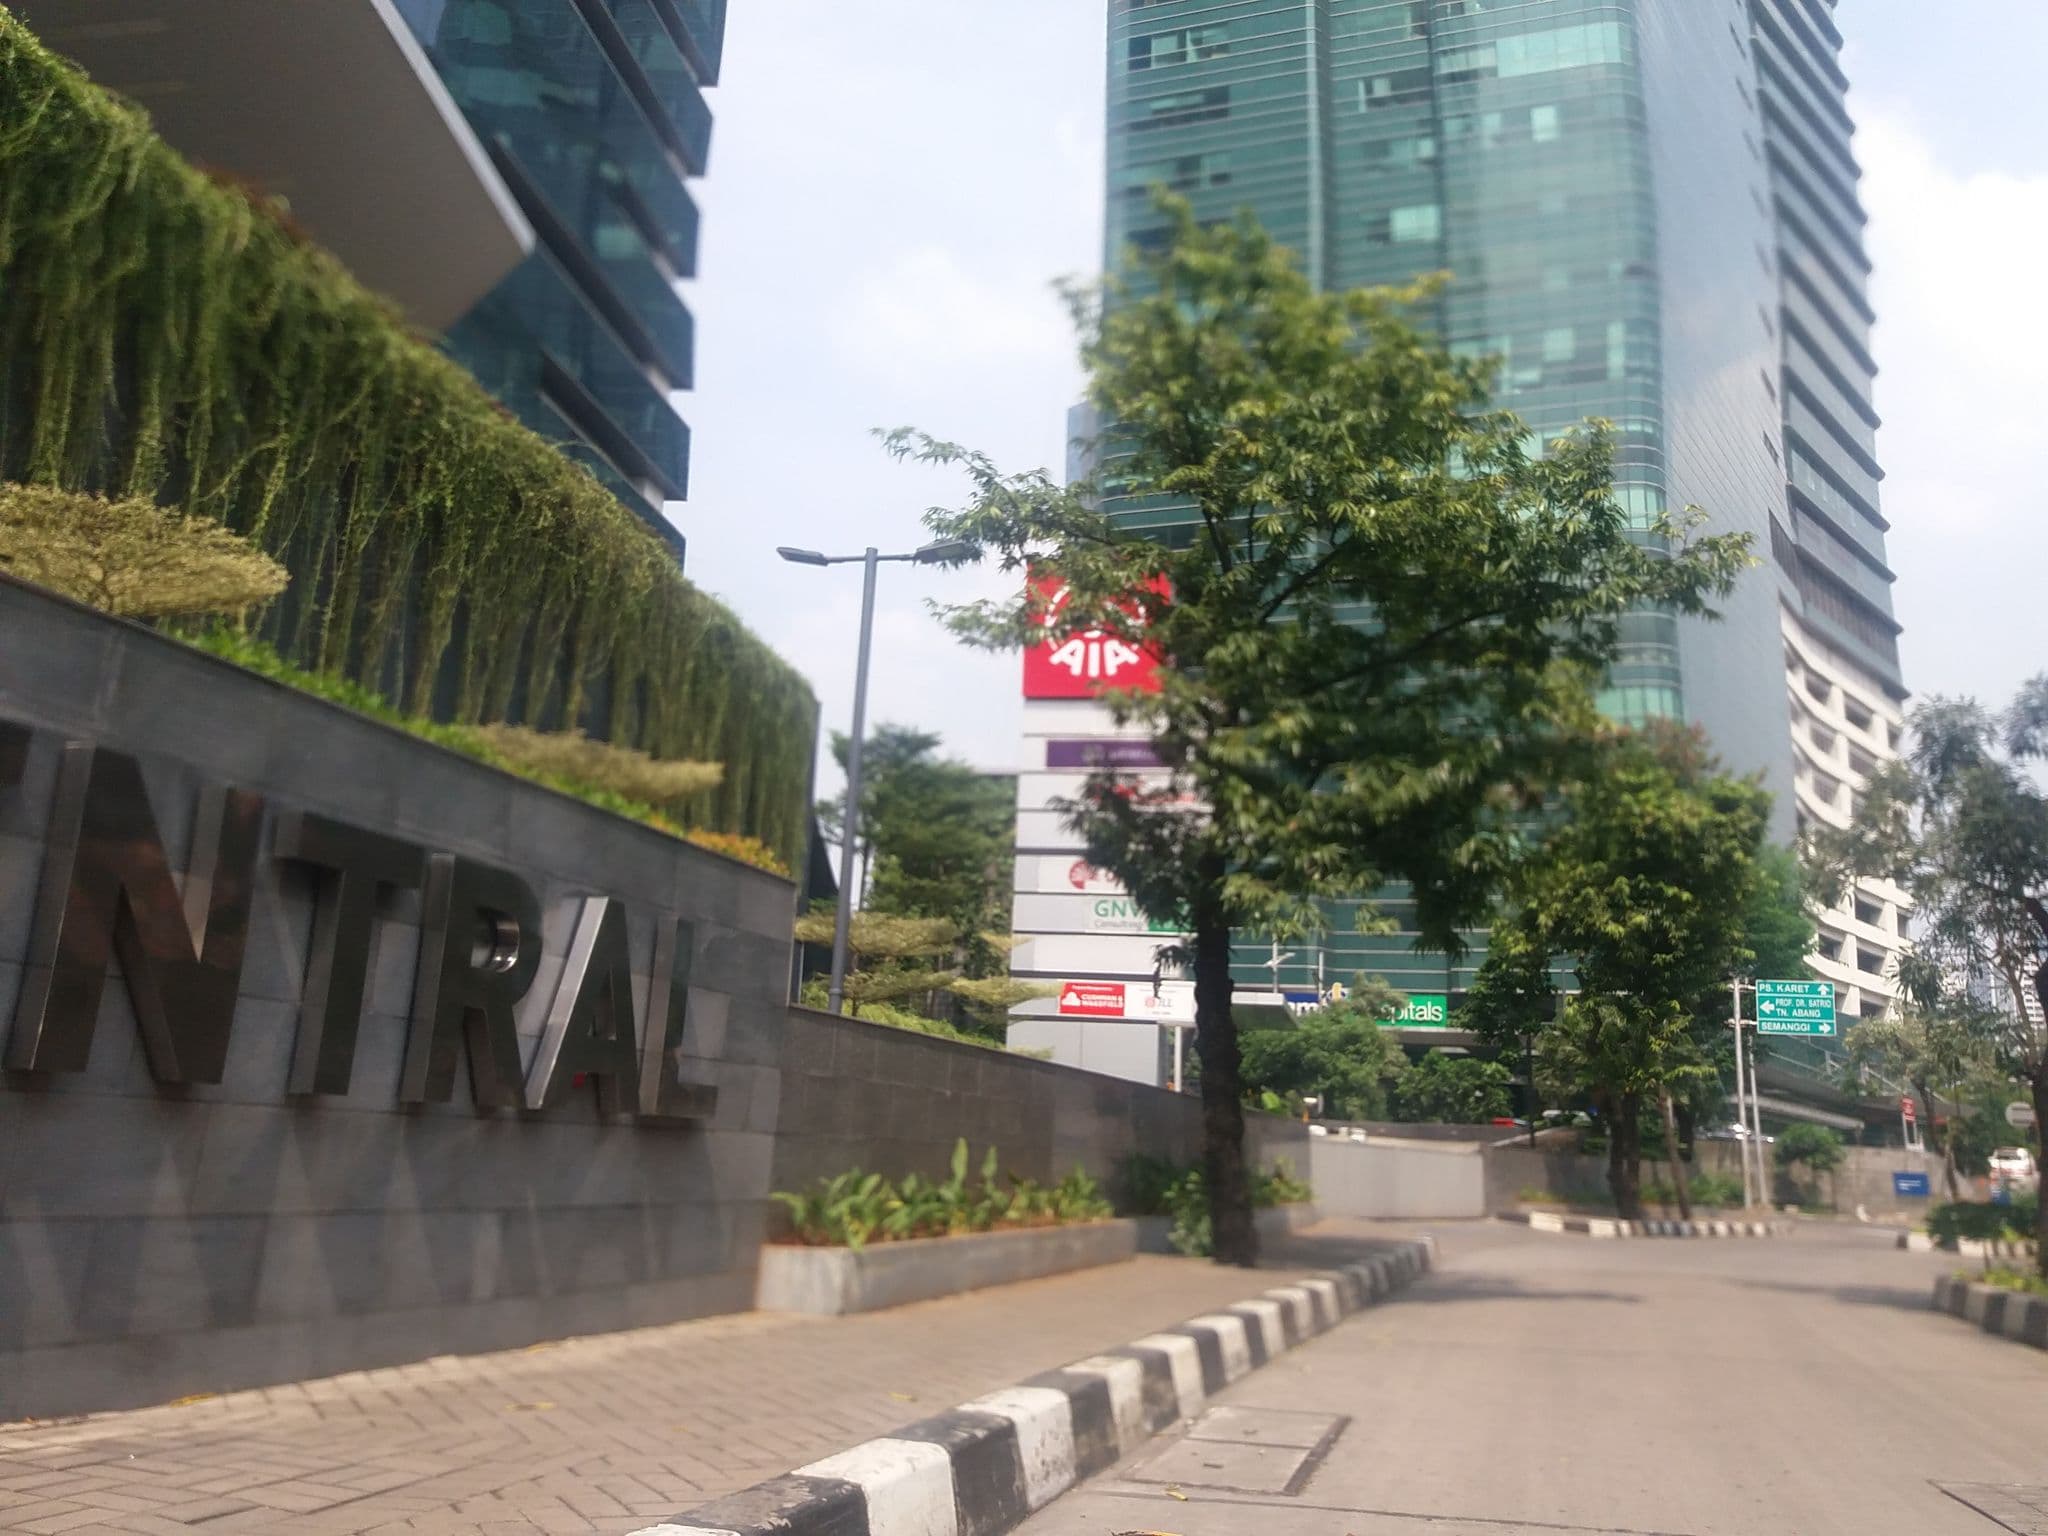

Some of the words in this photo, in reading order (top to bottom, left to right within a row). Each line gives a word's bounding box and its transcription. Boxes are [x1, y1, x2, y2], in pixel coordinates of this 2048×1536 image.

[1049, 639, 1140, 677] AIA
[0, 719, 720, 1119] NTRAL
[1776, 984, 1810, 993] KARET
[1792, 1009, 1821, 1018] ABANG
[1761, 1022, 1811, 1032] SEMANGGI
